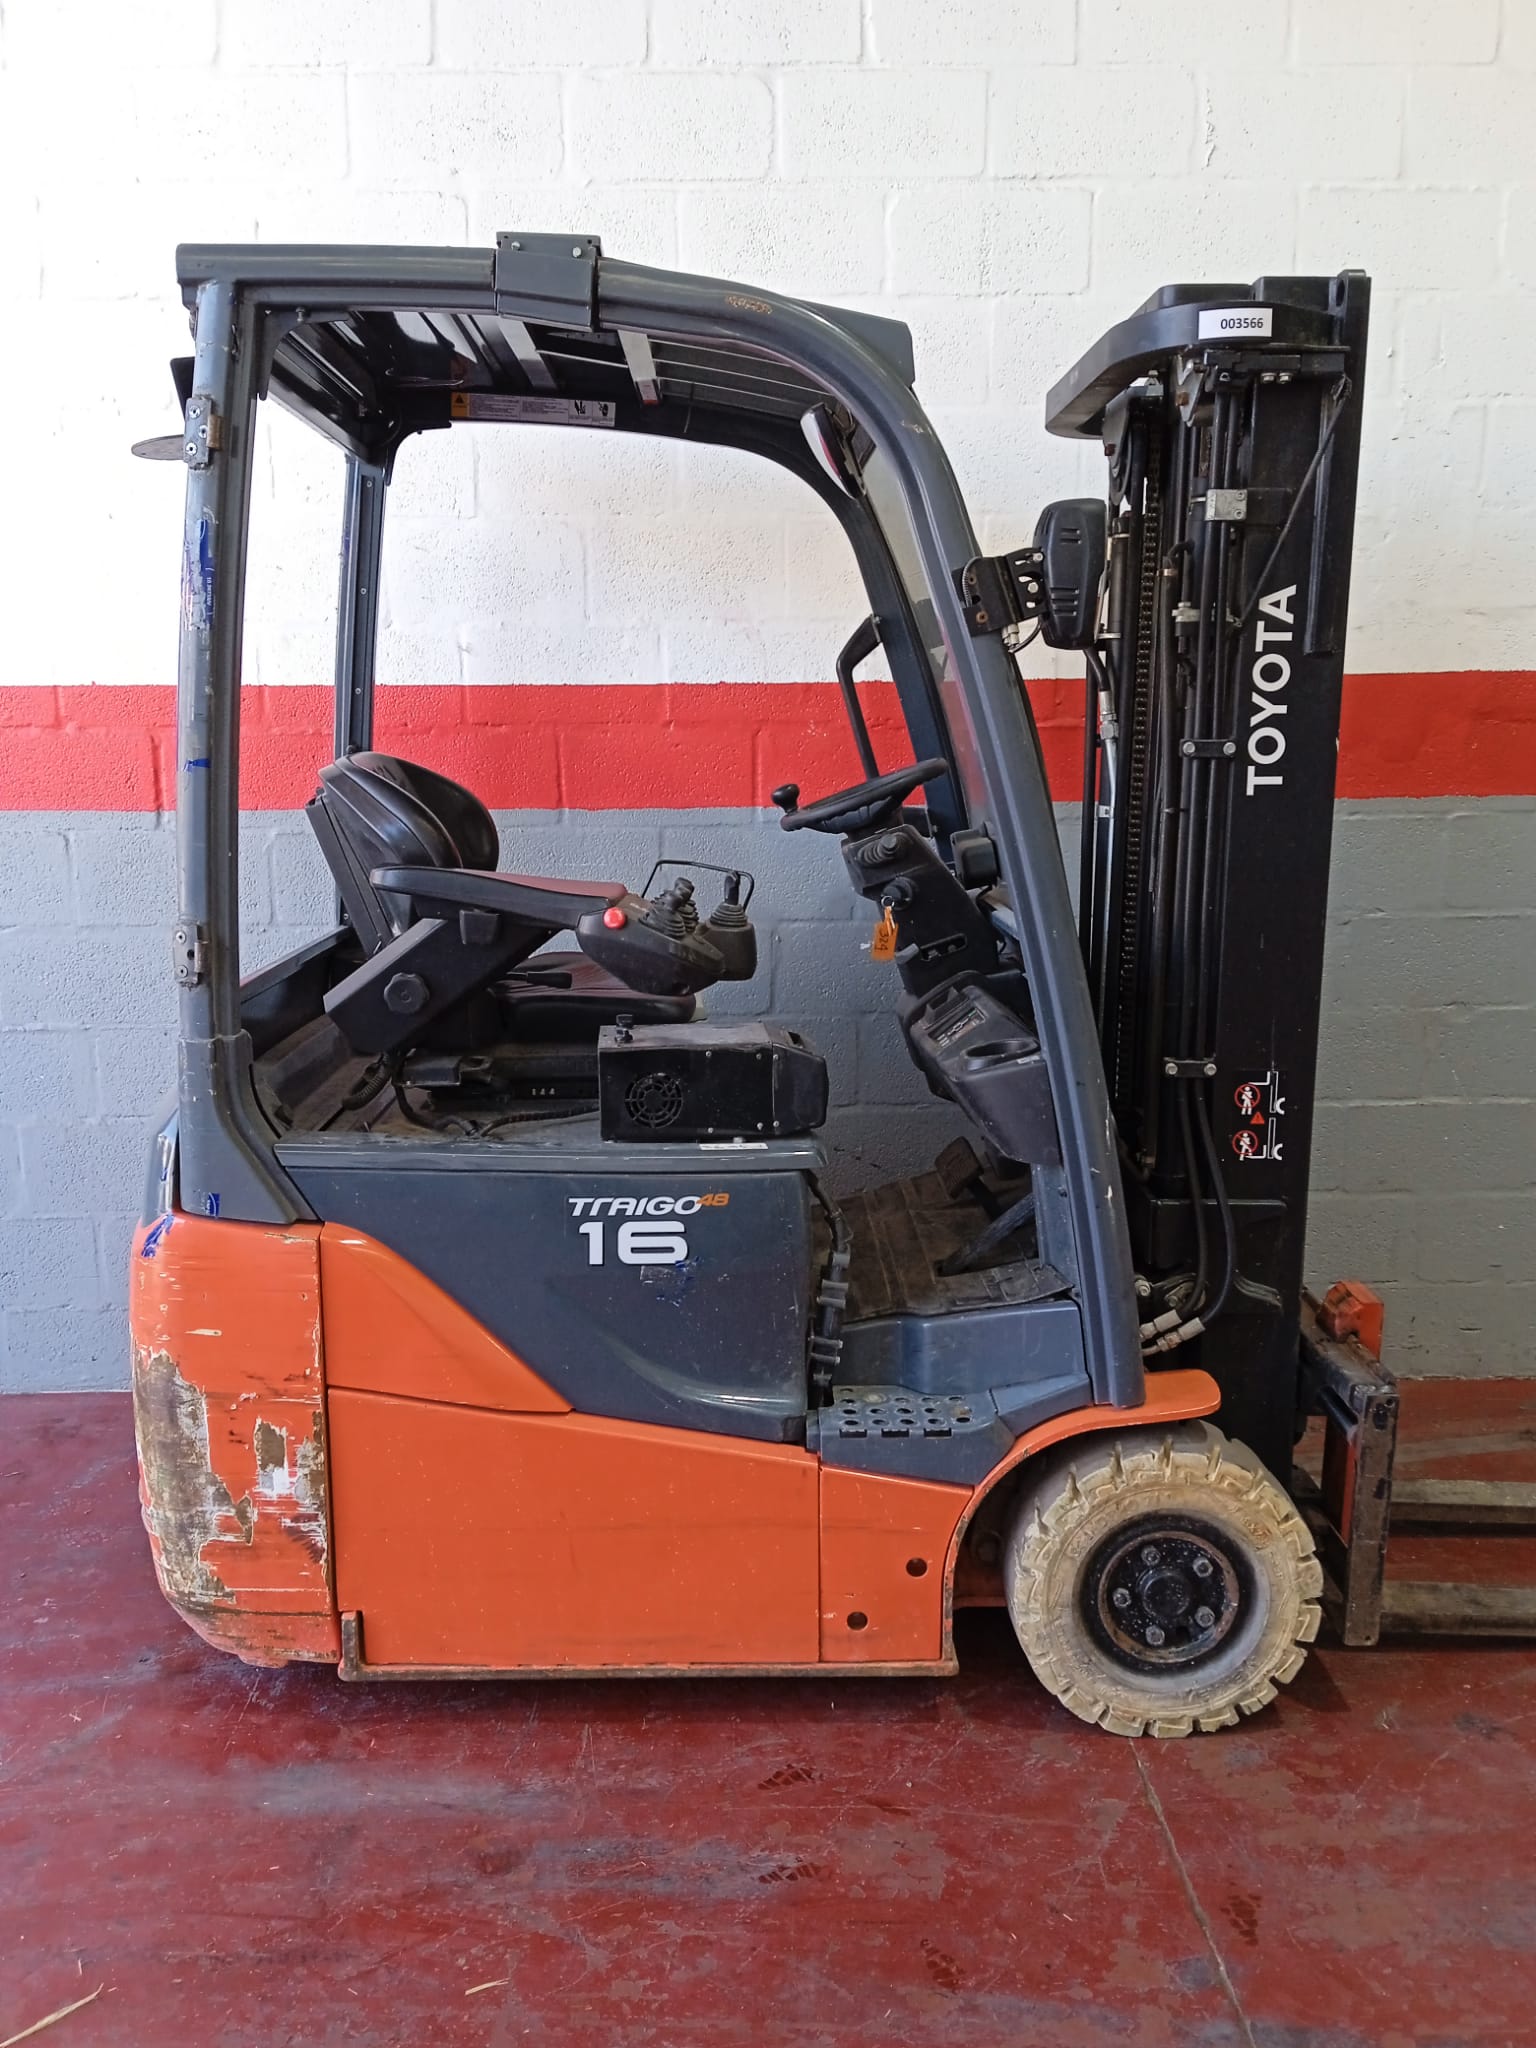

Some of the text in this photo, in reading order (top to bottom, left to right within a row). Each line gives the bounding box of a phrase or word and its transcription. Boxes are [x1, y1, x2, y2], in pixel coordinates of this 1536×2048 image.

[1220, 317, 1264, 330] 003566
[1246, 584, 1297, 796] TOYOTA
[568, 1195, 703, 1217] TRAIGO
[578, 1220, 688, 1266] 16
